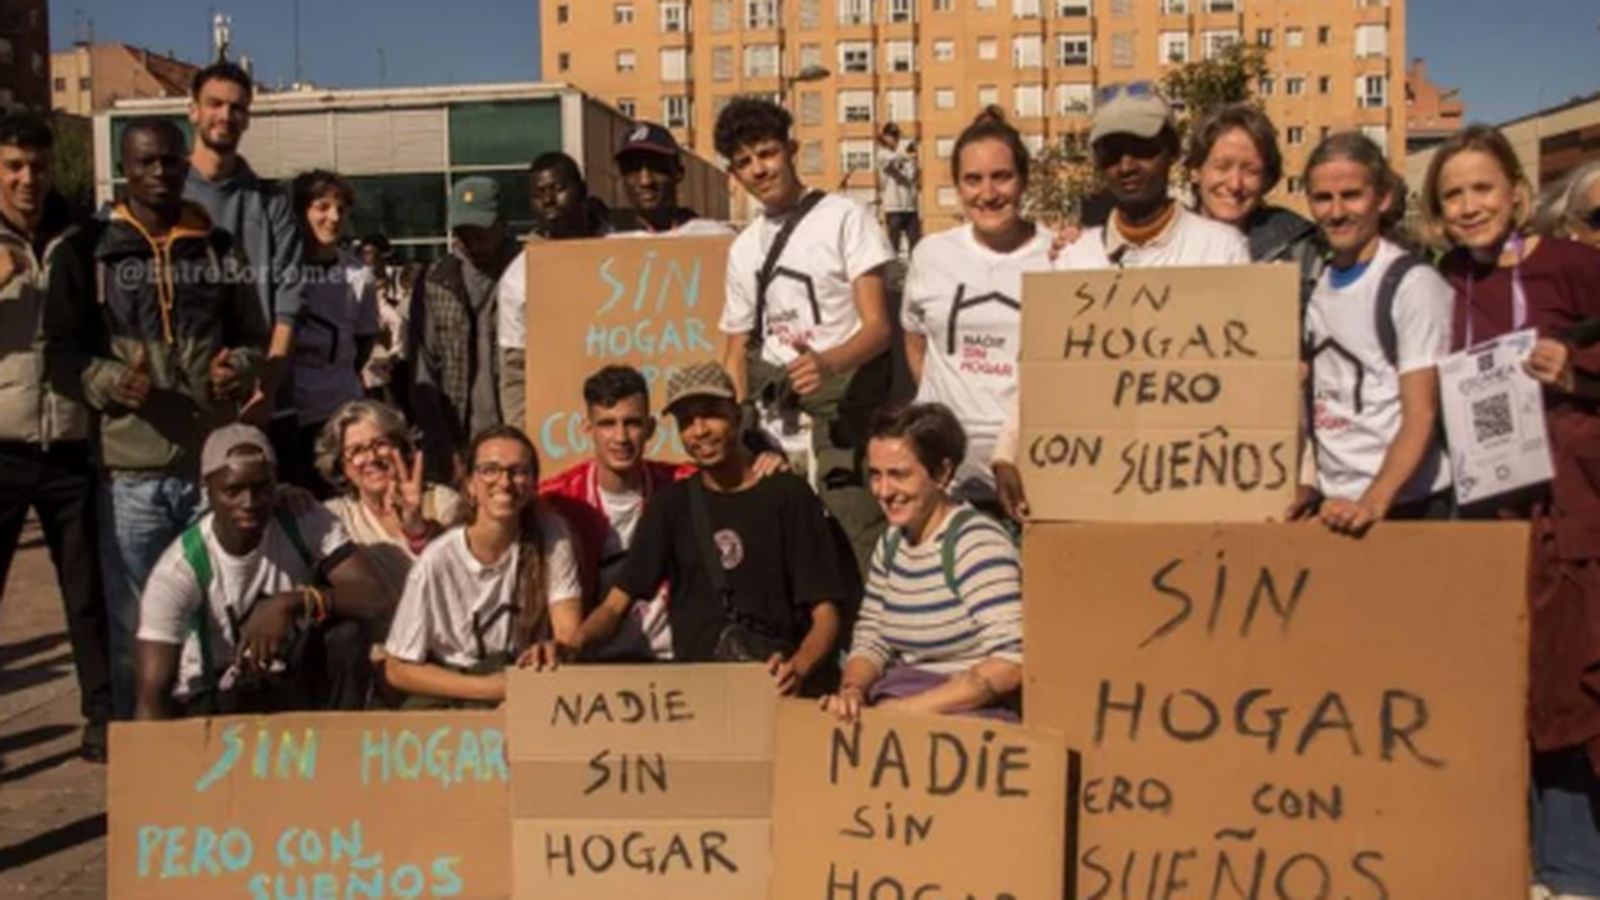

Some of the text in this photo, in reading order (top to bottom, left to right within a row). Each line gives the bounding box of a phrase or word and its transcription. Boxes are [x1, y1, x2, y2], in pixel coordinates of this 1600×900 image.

[585, 317, 715, 357] HOGAR
[962, 346, 987, 359] SIN
[1063, 319, 1258, 359] HOGAR
[959, 361, 1014, 377] HOGAR
[1112, 369, 1222, 407] PERO
[539, 410, 595, 459] CO
[1028, 425, 1288, 495] CON SUEÑOS
[1093, 679, 1450, 769] HOGAR
[361, 724, 511, 790] HOGAR
[583, 749, 668, 795] SIN
[1082, 776, 1342, 820] ERO CON
[136, 819, 365, 878] PERO CON
[544, 831, 738, 877] HOGAR
[1081, 827, 1390, 900] SUEÑOS
[247, 852, 463, 900] SUEÑOS
